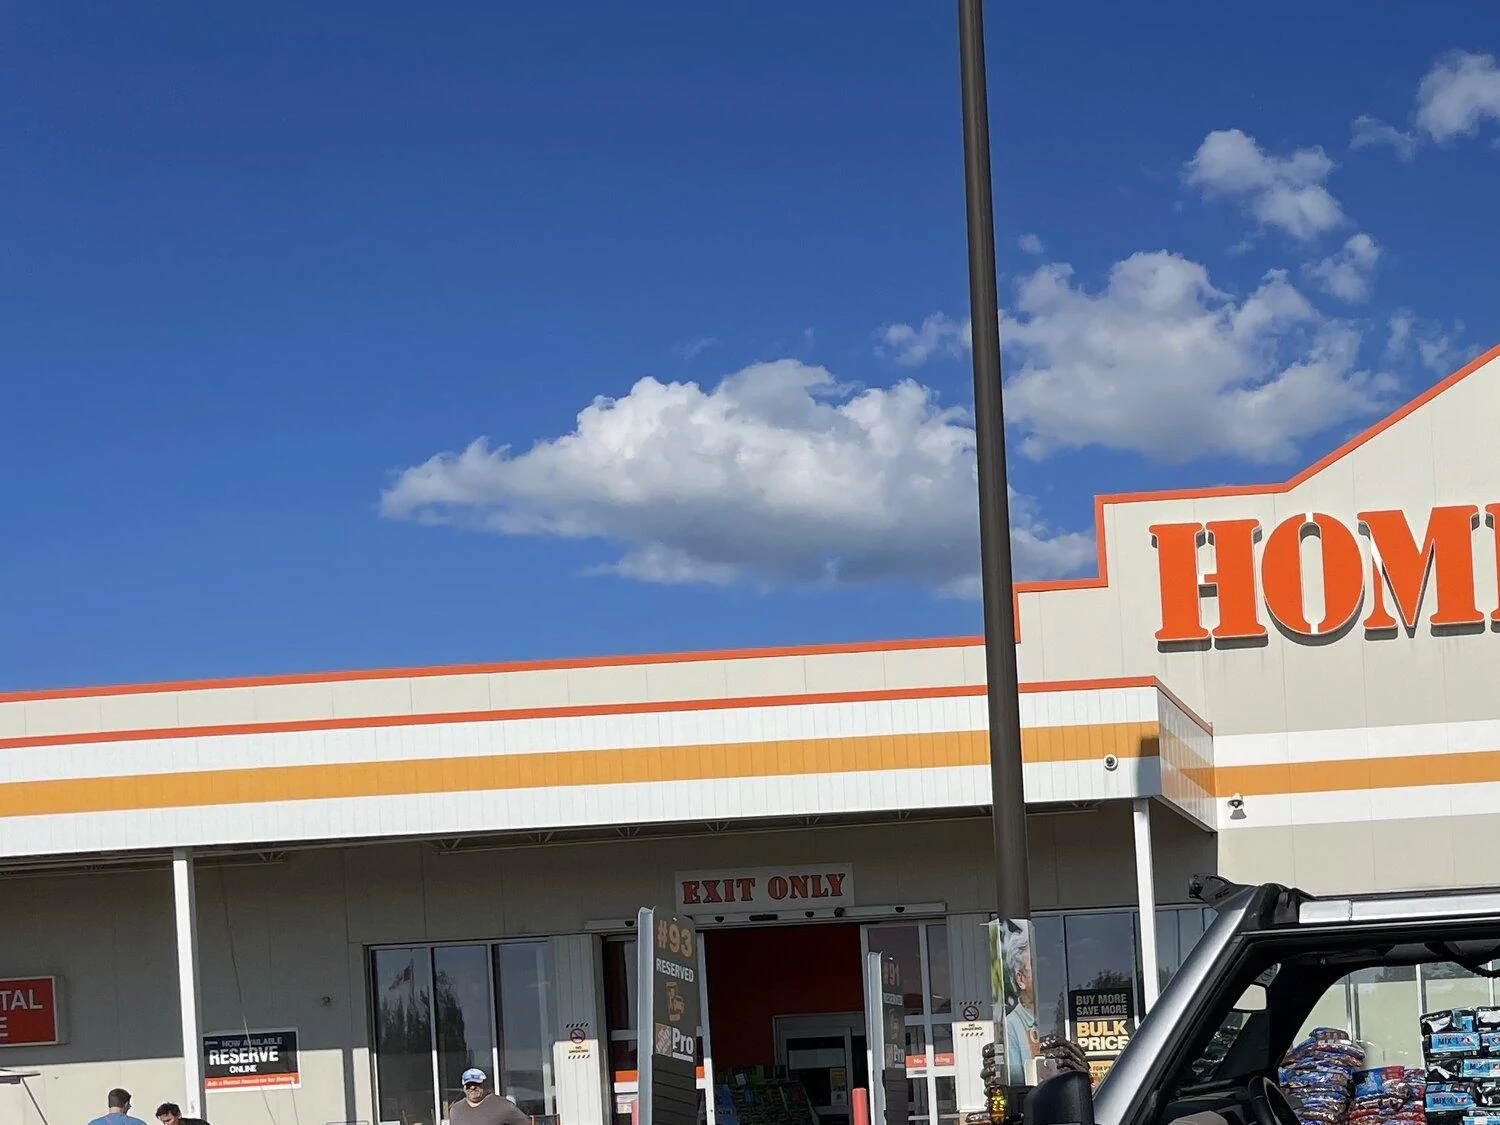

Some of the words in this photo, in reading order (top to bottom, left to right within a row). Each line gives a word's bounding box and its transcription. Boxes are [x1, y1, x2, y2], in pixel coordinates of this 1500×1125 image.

[682, 878, 756, 904] EXIT
[768, 873, 846, 900] ONLY
[656, 920, 692, 957] #93
[656, 958, 694, 982] RESERVED
[1076, 995, 1095, 1006] BUY
[1098, 993, 1127, 1004] MORE
[1076, 1005, 1099, 1016] SAVE
[1101, 1004, 1127, 1014] MORE
[1076, 1020, 1129, 1037] BULK
[243, 1037, 283, 1046] AVAILABLE
[672, 1026, 694, 1055] Pro
[1077, 1035, 1130, 1051] PRICE
[209, 1046, 279, 1066] RESERVE
[229, 1065, 257, 1074] ONLINE
